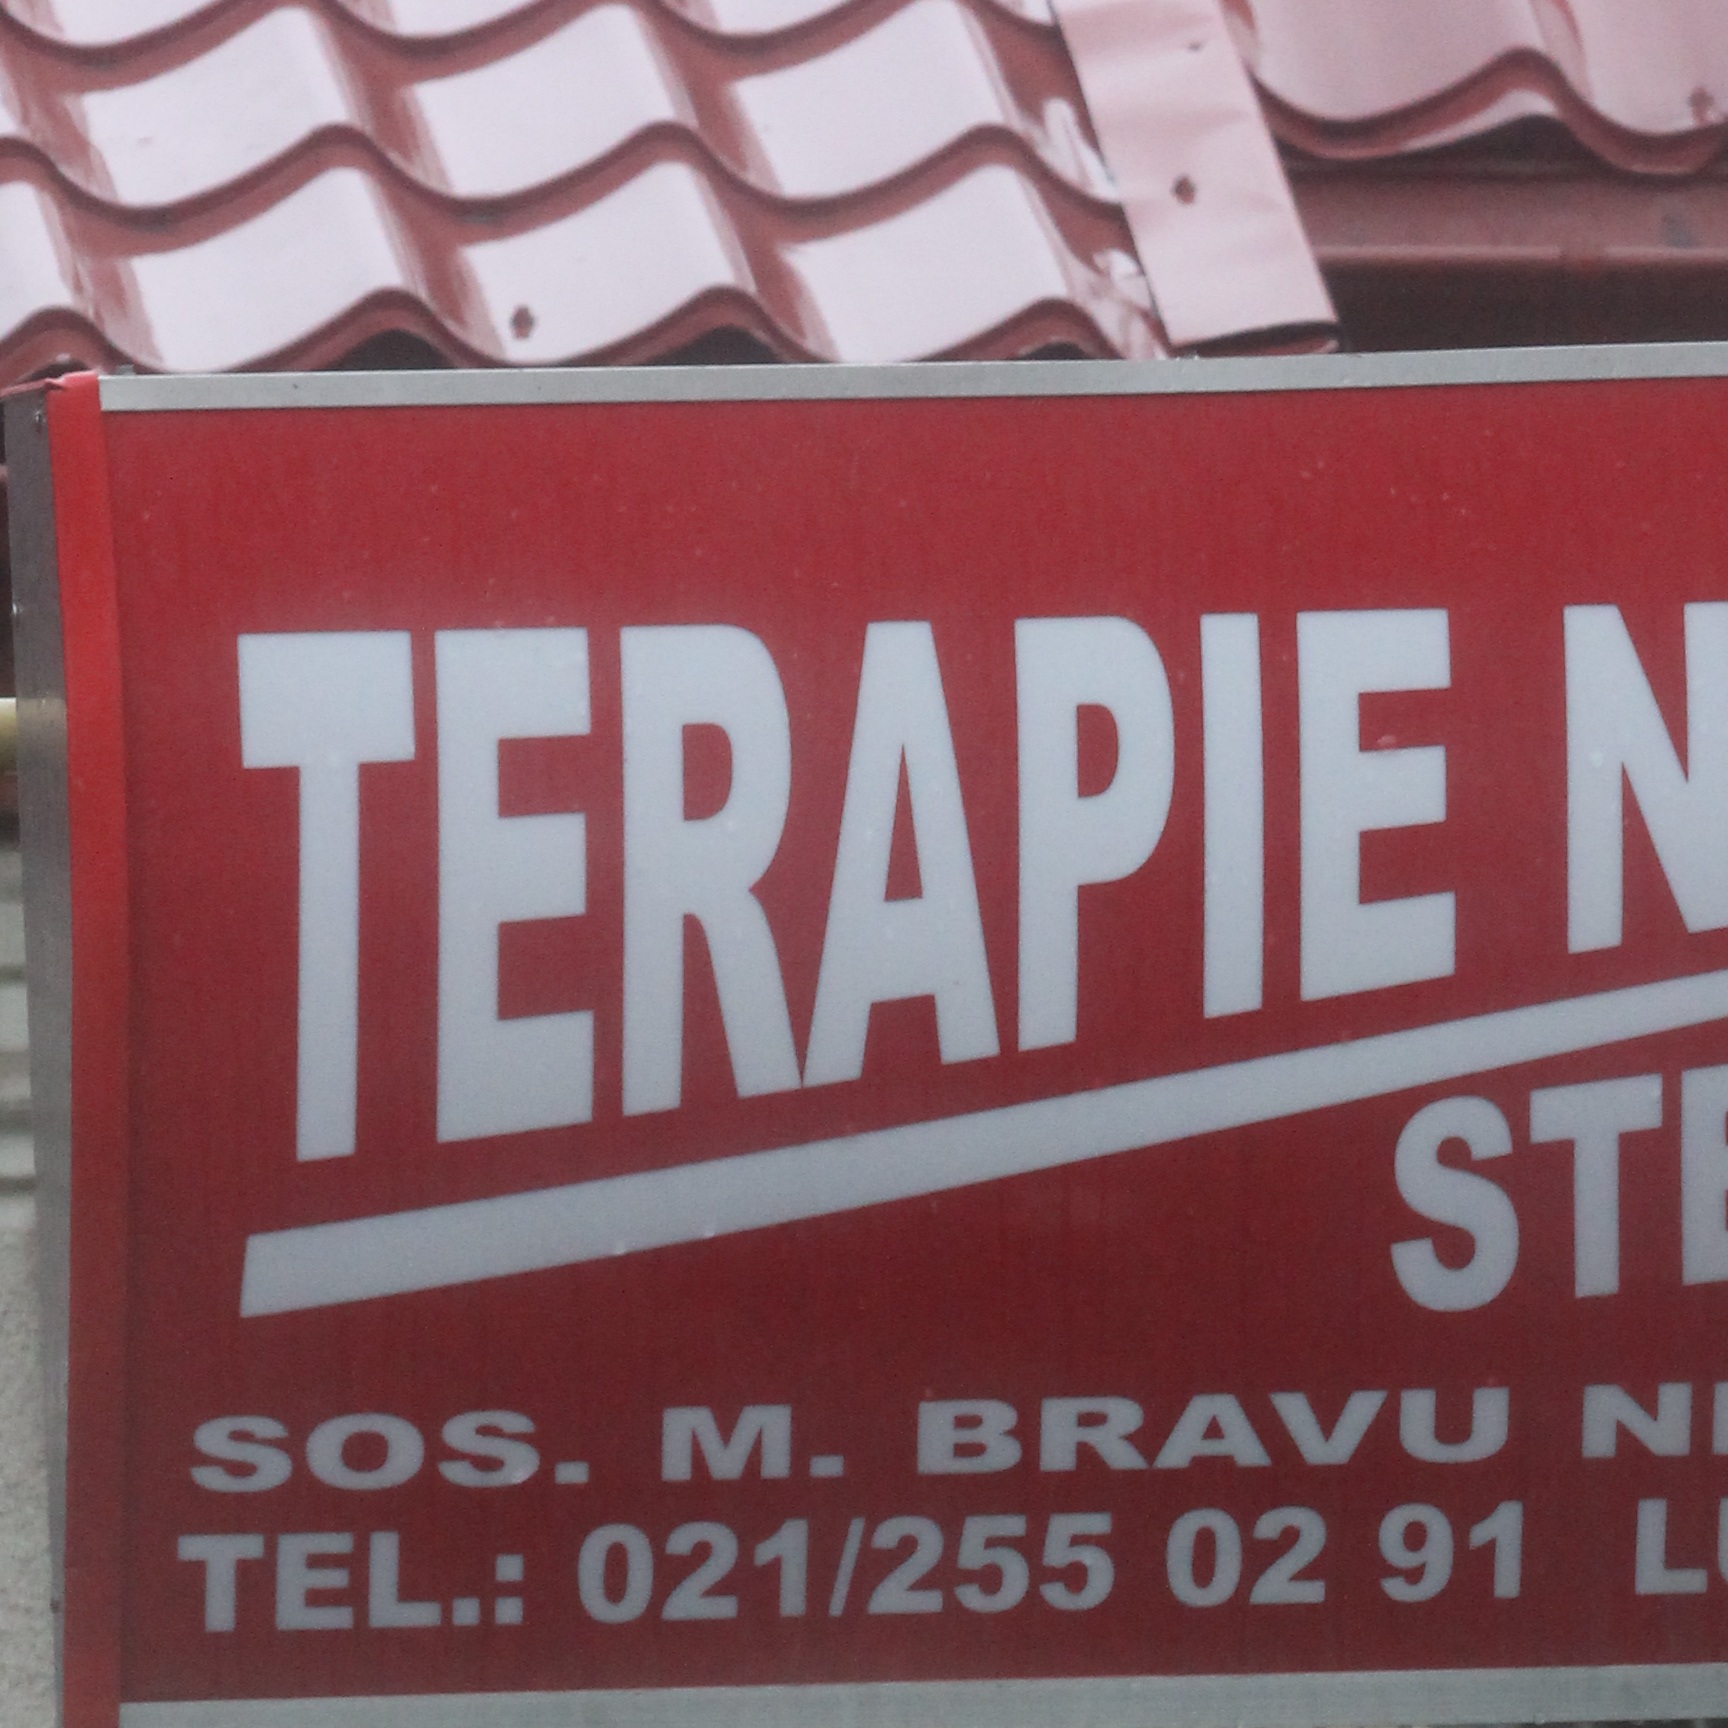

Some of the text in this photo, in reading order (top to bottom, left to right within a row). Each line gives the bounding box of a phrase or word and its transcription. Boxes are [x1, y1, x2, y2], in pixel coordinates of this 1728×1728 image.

[236, 607, 1456, 1164] TERAPIE
[189, 1408, 590, 1493] SOS.
[660, 1403, 845, 1481] M.
[915, 1386, 1511, 1476] BRAVU
[178, 1530, 525, 1634] TEL.:
[577, 1512, 1116, 1625] 021/255
[1165, 1506, 1328, 1608] 02
[1377, 1501, 1524, 1604] 91
